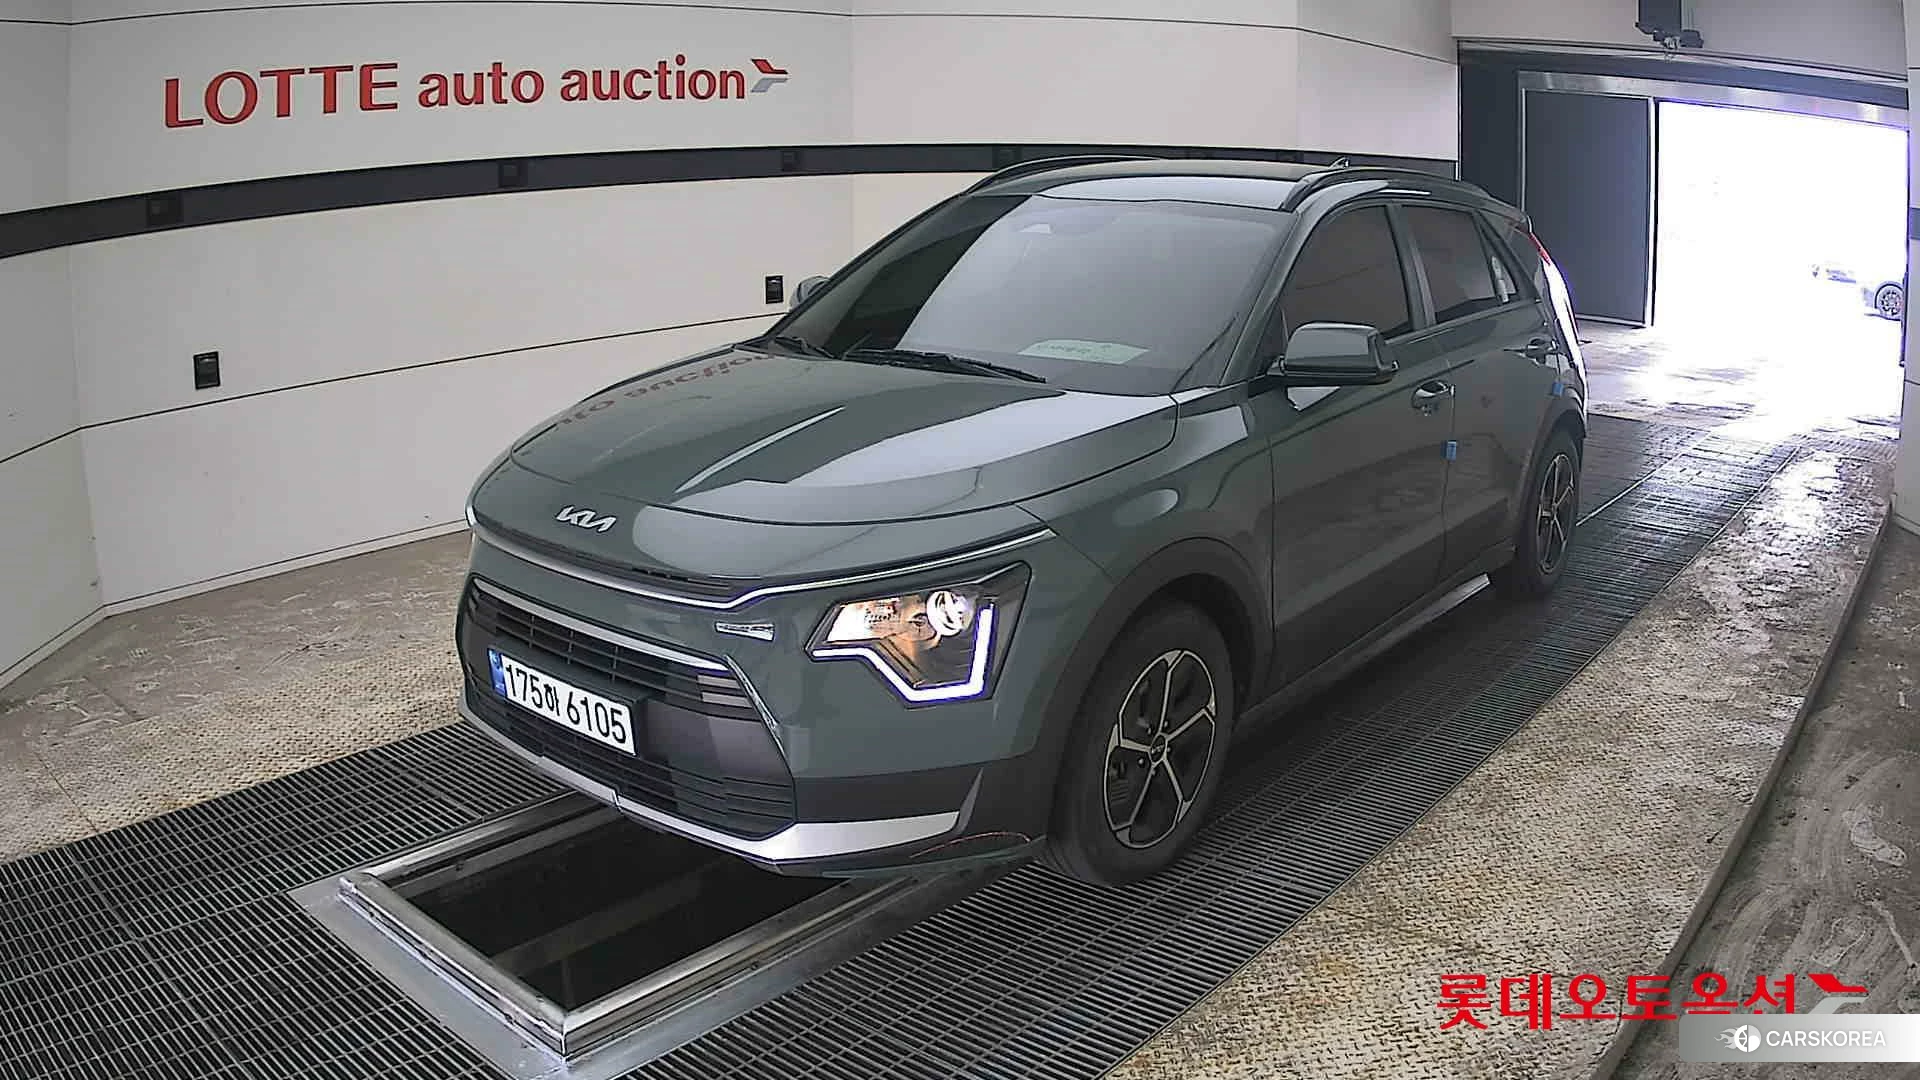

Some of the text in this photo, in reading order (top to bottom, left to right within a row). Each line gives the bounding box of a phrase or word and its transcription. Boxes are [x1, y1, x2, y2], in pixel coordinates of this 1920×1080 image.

[164, 53, 746, 129] LOTTE auto auction
[555, 505, 617, 533] KIA
[505, 664, 627, 744] 175하 6105
